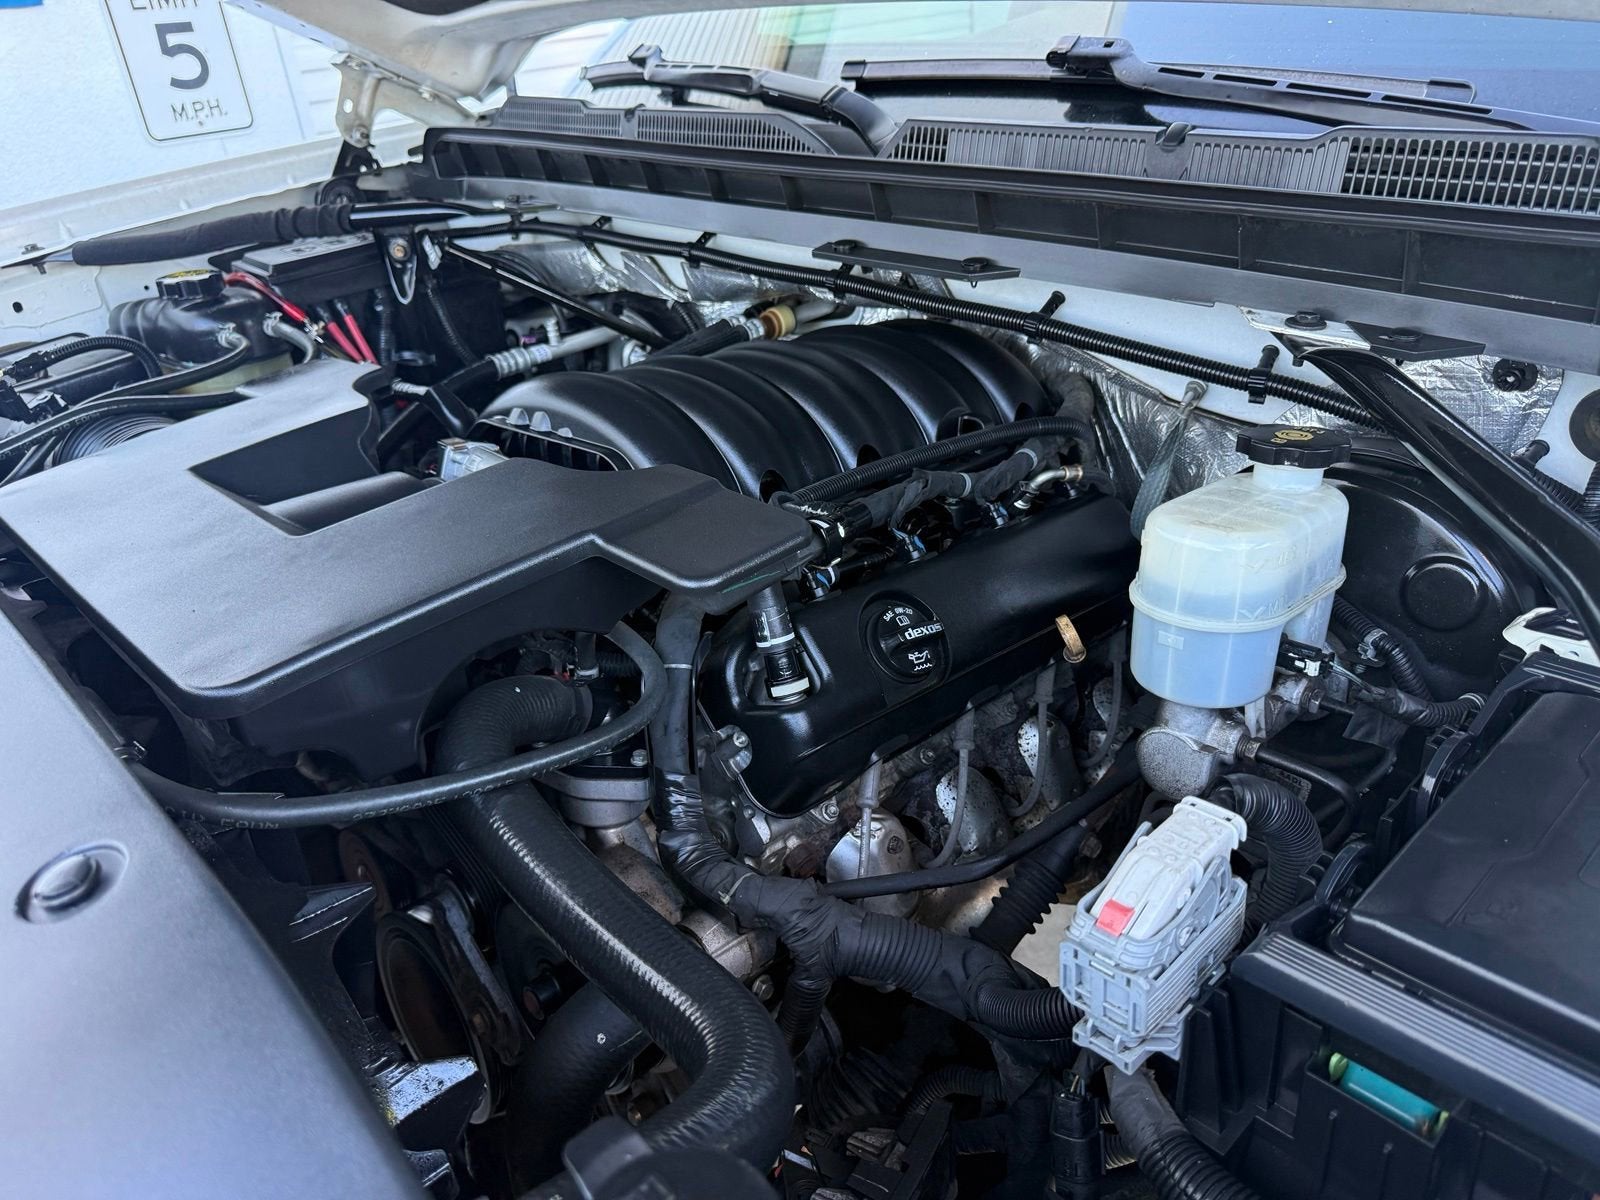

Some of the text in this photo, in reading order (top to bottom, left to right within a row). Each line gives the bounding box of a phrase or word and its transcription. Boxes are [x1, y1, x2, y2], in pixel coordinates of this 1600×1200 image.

[155, 21, 210, 90] 5
[171, 99, 228, 122] M.P.H.
[883, 610, 895, 622] SAE
[904, 623, 942, 639] dexos
